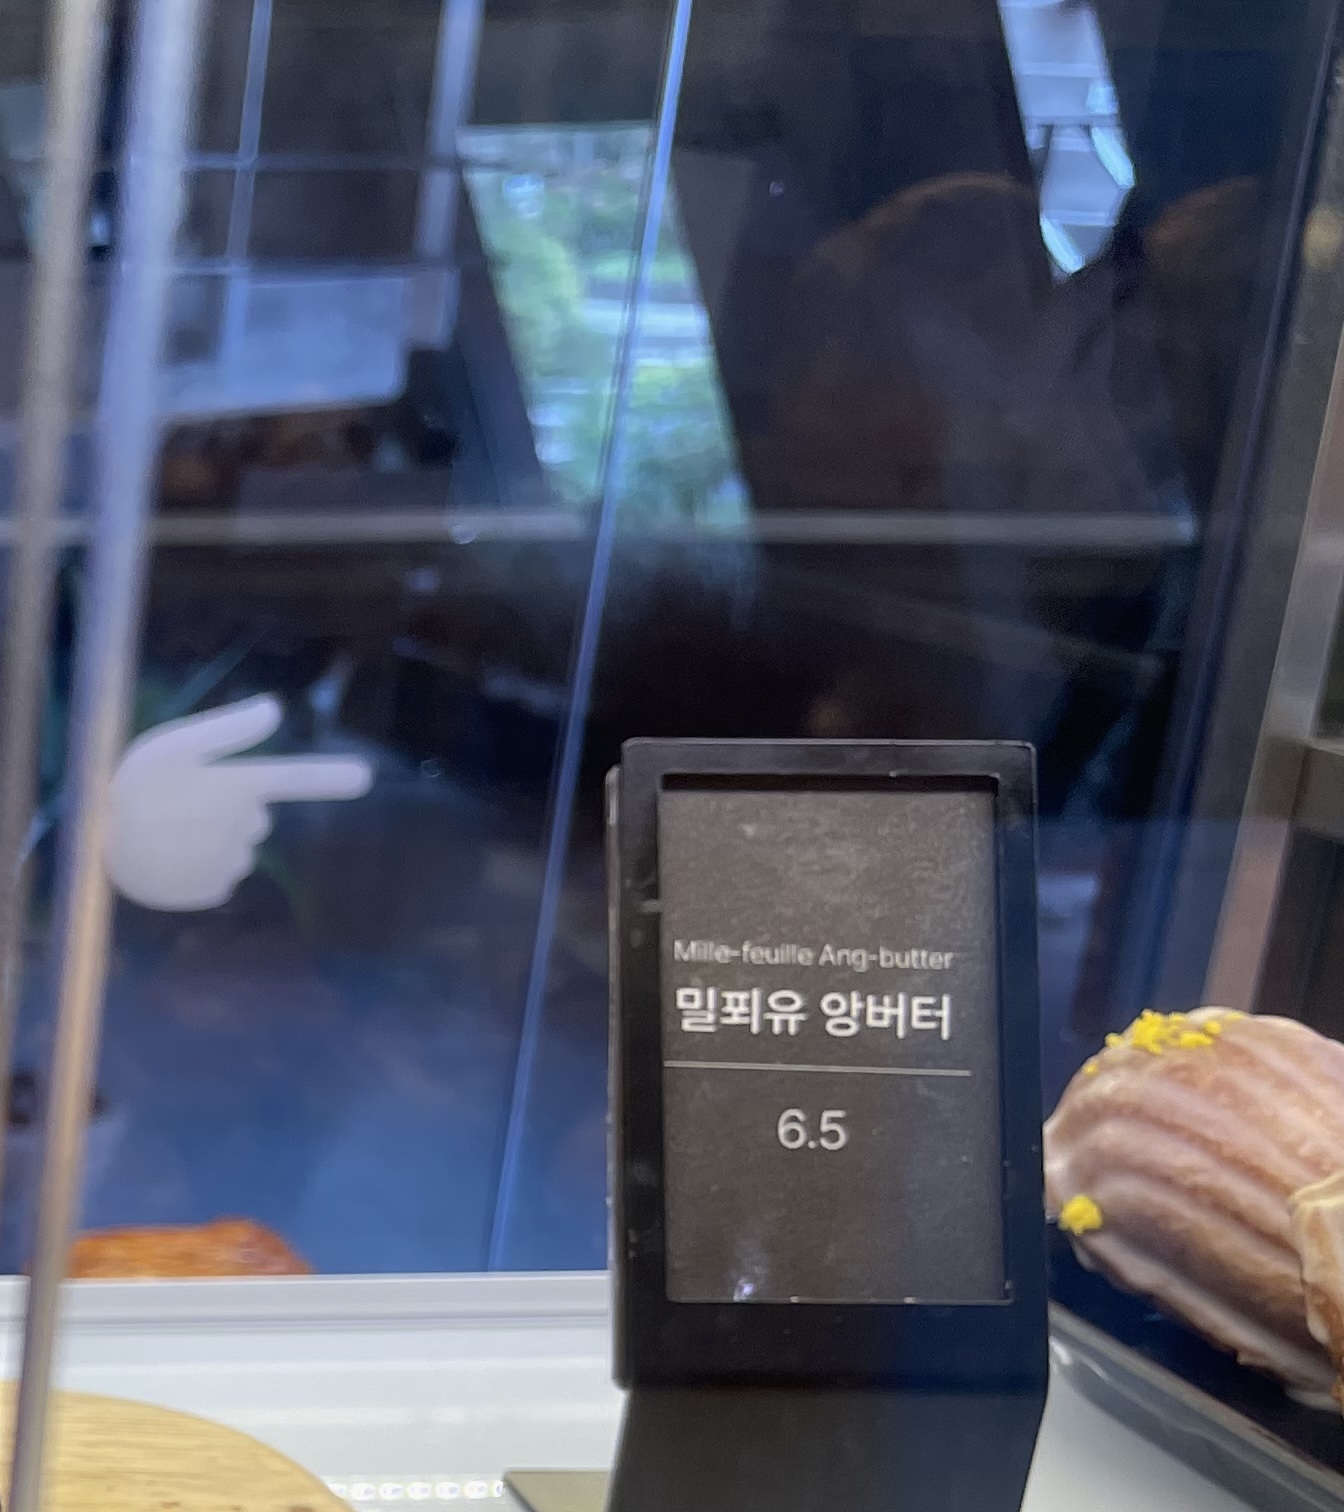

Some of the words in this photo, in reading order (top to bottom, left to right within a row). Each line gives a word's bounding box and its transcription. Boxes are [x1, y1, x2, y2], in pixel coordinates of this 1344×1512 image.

[673, 940, 814, 966] Mille-feuille
[818, 943, 954, 973] Ang-butter
[675, 986, 809, 1036] 밀푀유
[819, 990, 951, 1040] 앙버터
[777, 1108, 847, 1150] 6.5
